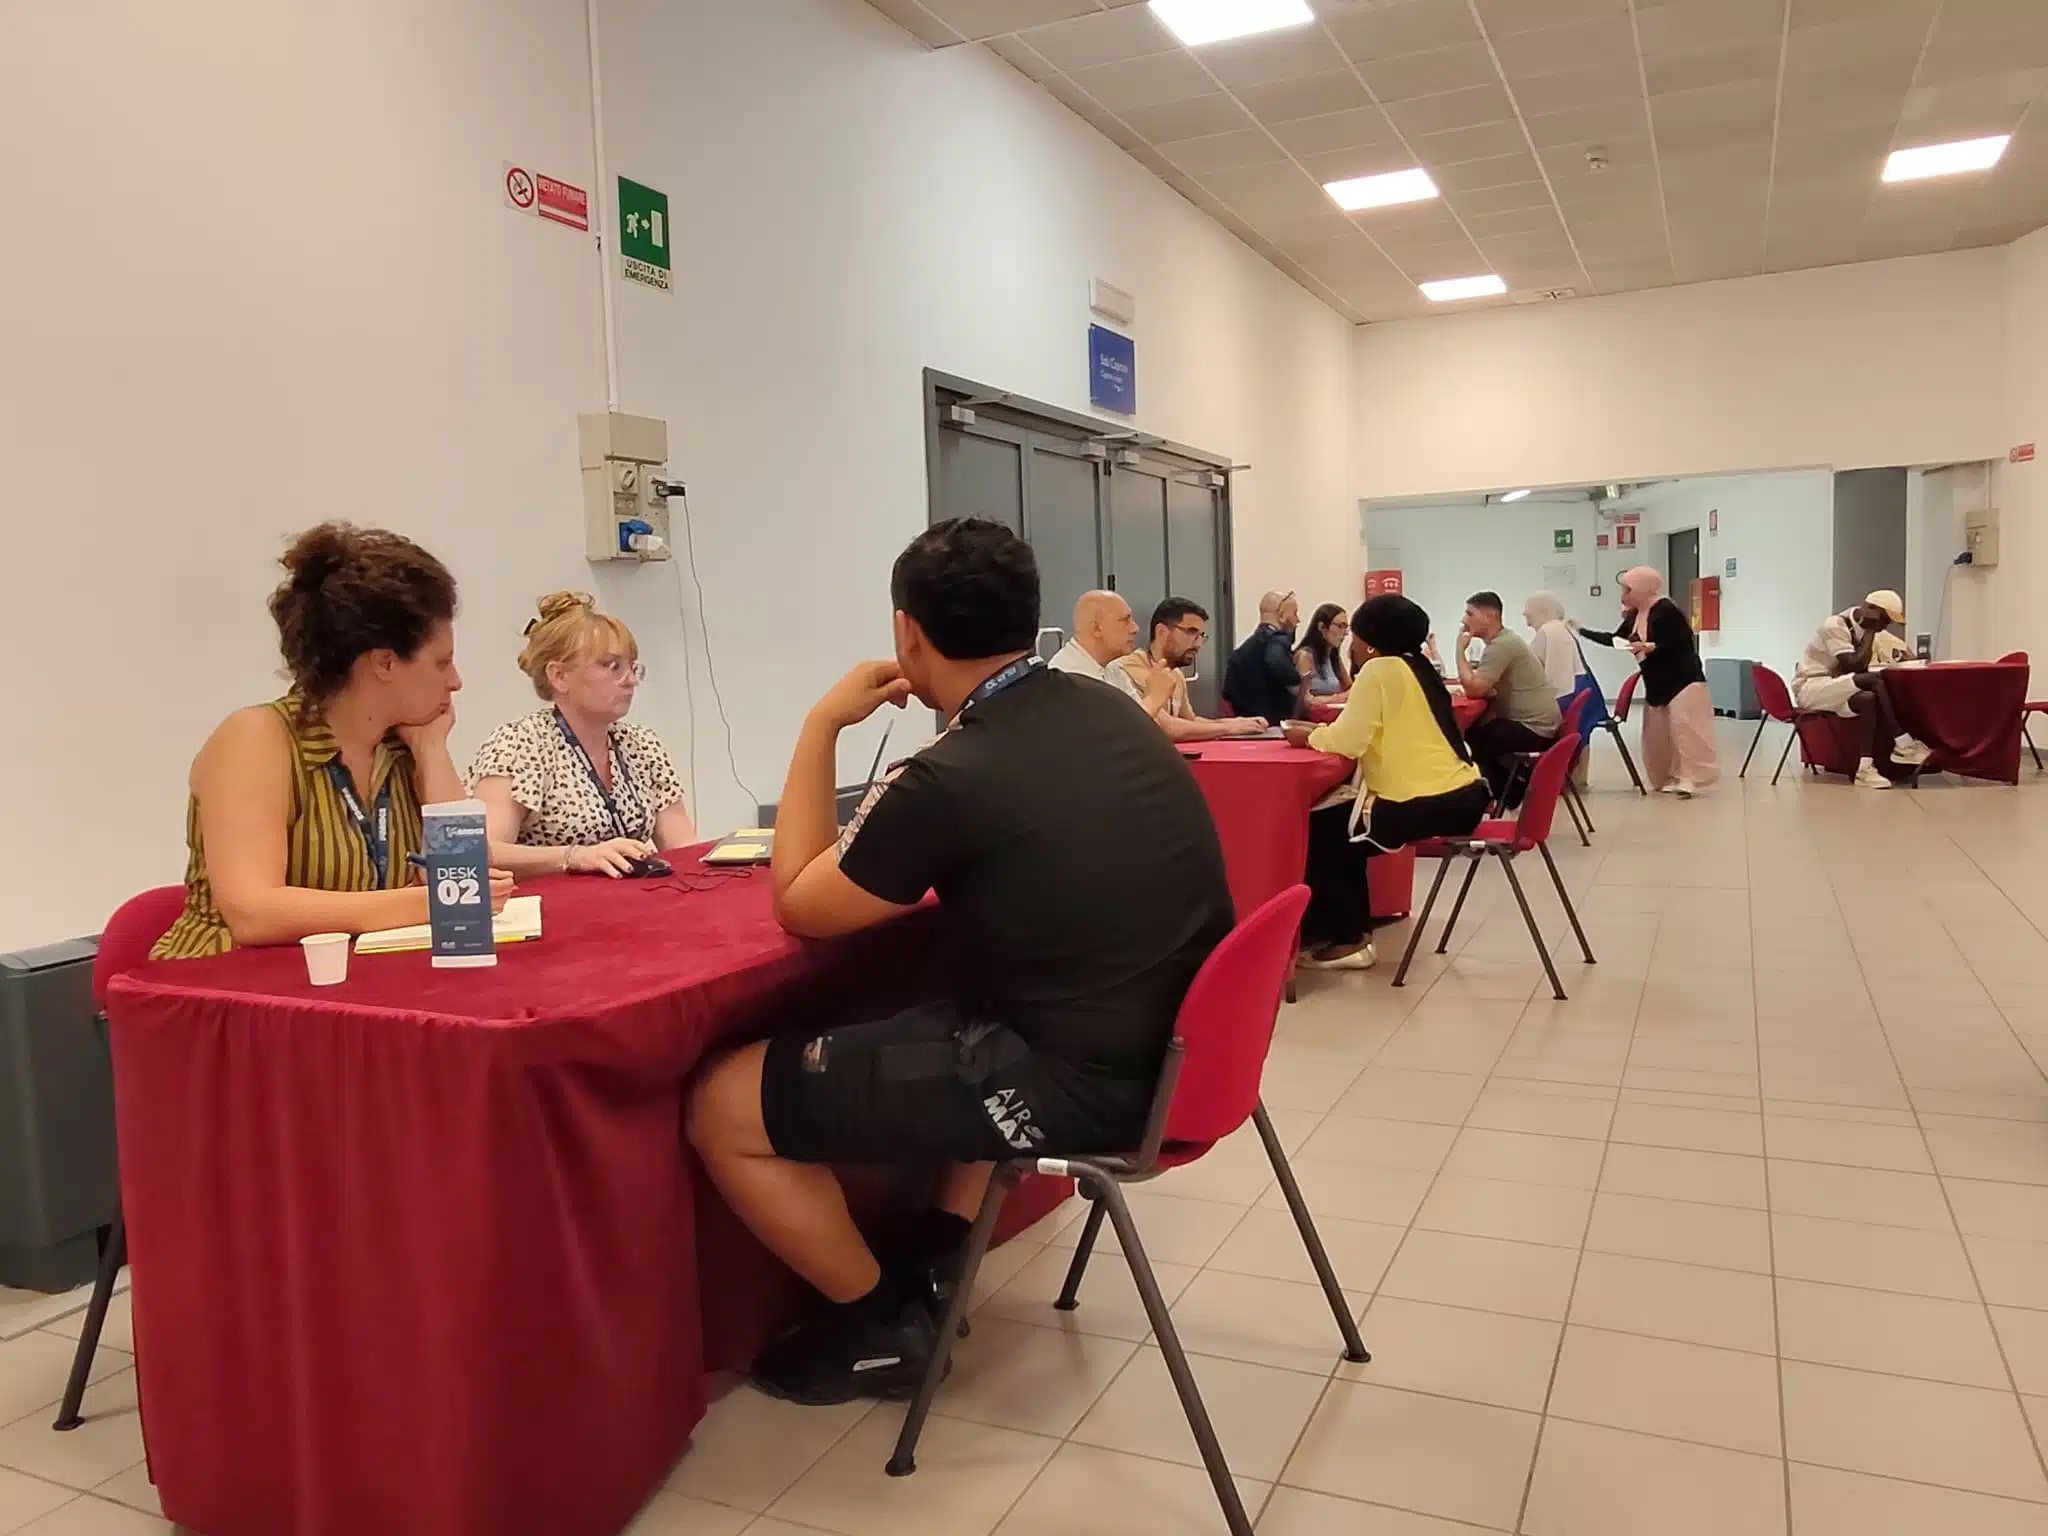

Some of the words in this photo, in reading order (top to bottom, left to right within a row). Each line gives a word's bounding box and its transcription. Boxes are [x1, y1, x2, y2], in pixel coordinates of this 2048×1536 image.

[625, 268, 669, 289] EMERGENZA
[626, 259, 656, 276] USCITA
[658, 269, 667, 280] DI
[436, 866, 478, 880] DESK
[437, 878, 481, 906] 02
[997, 1089, 1031, 1124] AIR
